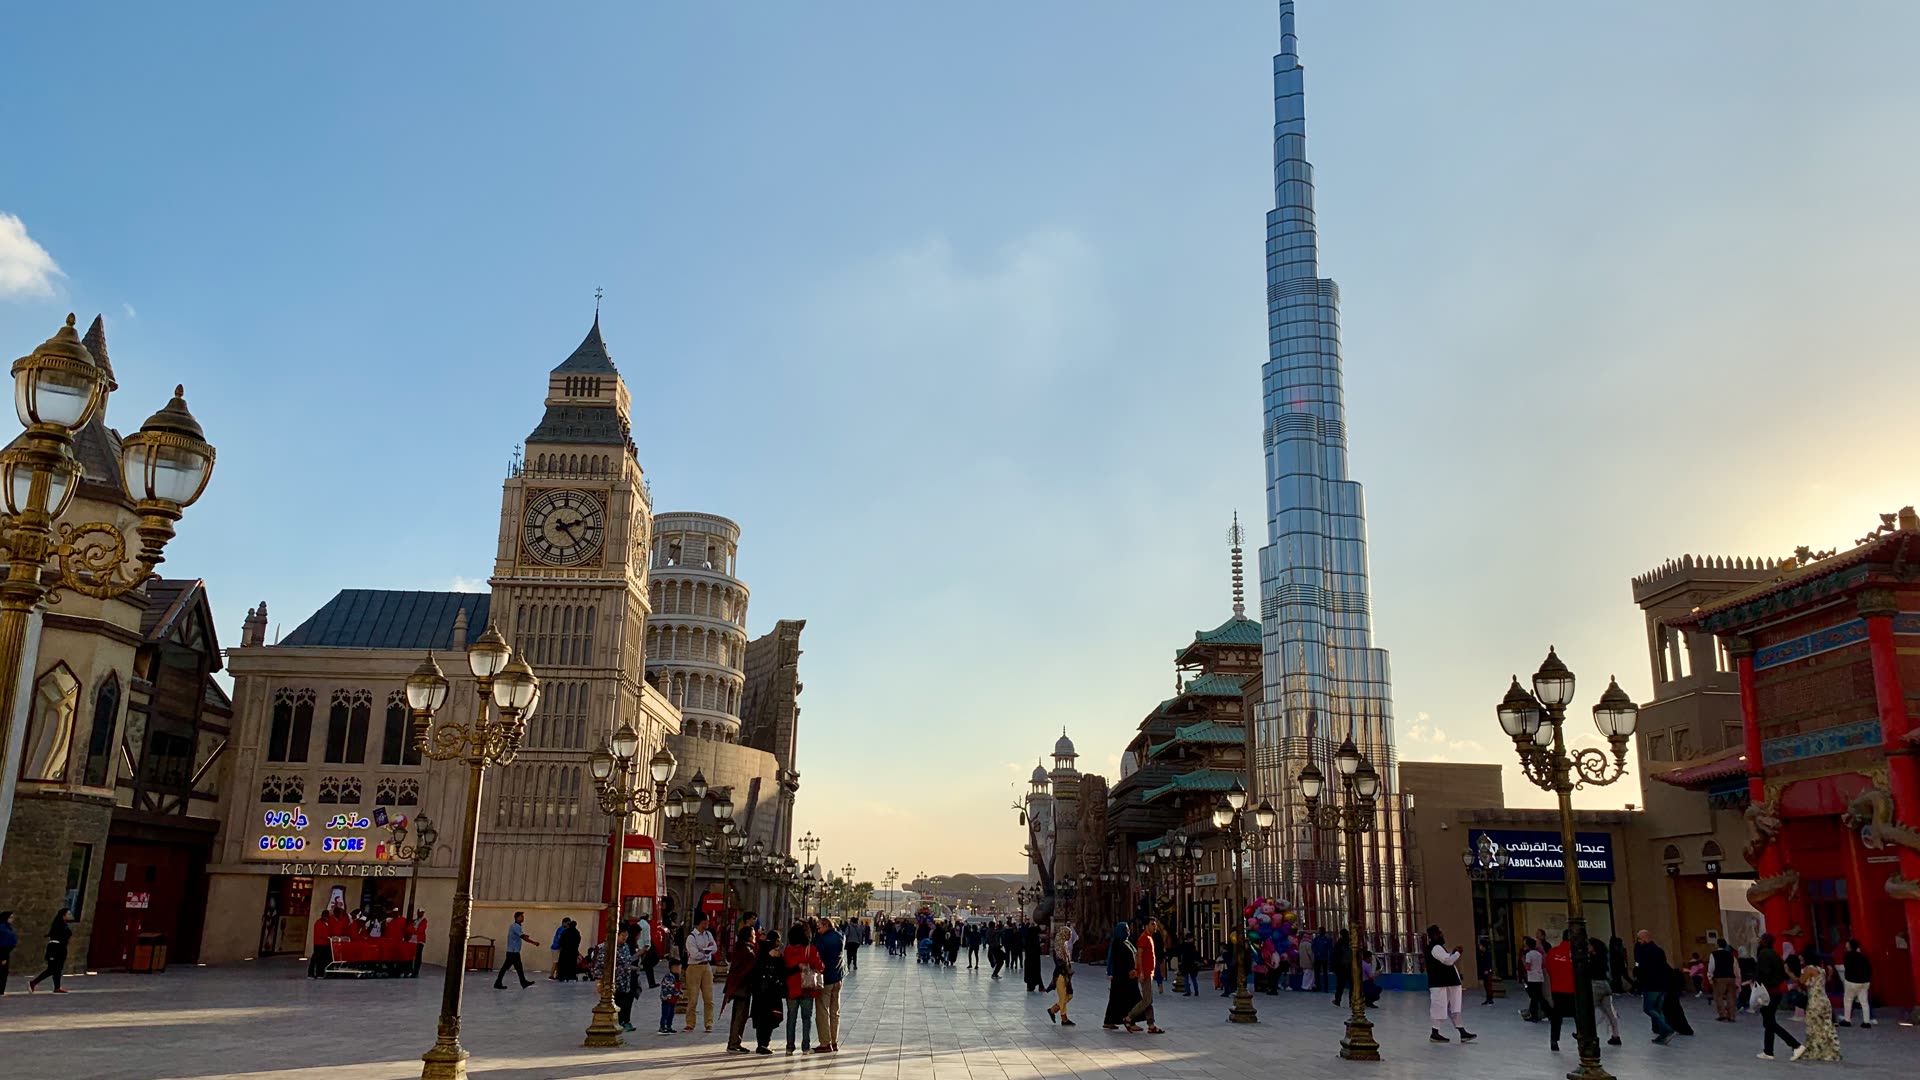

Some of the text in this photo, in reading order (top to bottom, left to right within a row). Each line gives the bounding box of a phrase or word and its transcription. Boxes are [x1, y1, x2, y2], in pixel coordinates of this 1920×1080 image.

[326, 813, 370, 830] متجر
[259, 835, 365, 852] GLOBO STORE
[281, 863, 397, 877] KEVENTERS
[1508, 857, 1607, 869] ABDUL SAMAD URASHI
